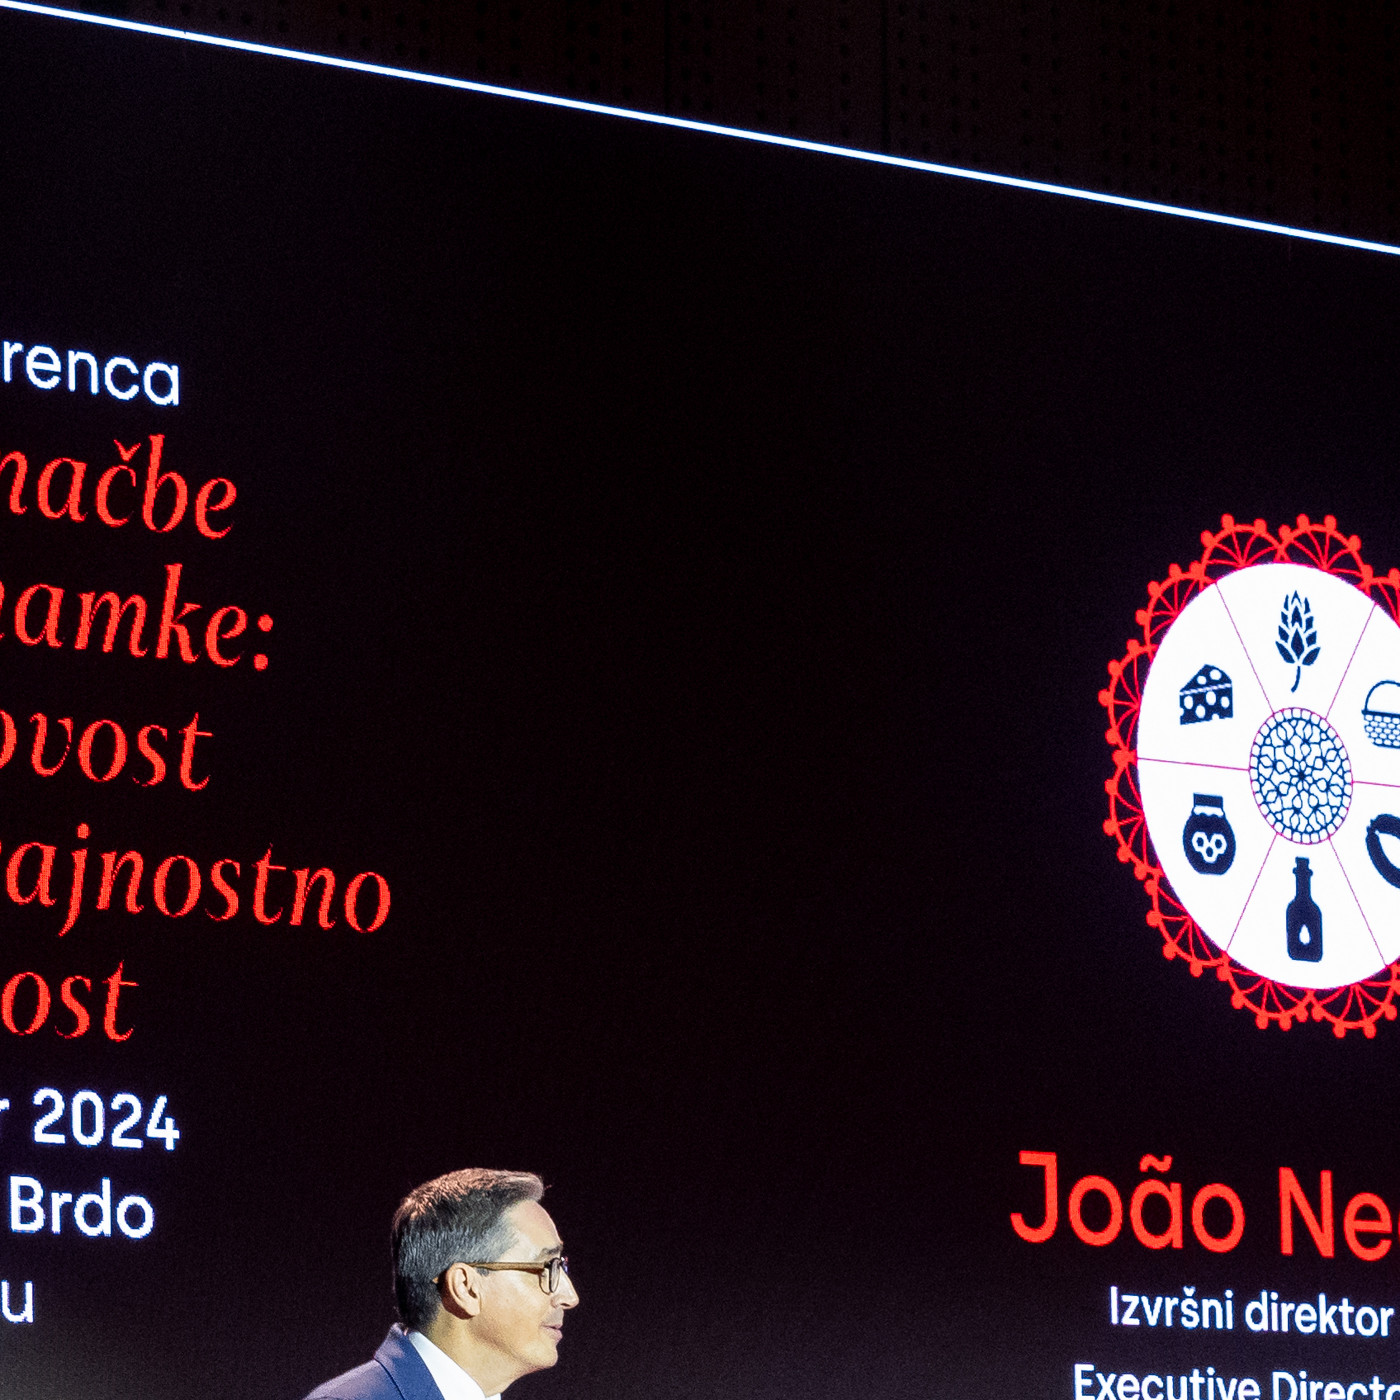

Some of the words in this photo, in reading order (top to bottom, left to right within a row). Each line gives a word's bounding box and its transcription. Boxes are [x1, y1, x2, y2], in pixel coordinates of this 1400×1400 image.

[30, 1085, 181, 1152] 2024
[8, 1174, 156, 1241] Brdo
[1008, 1149, 1247, 1255] João
[1108, 1284, 1235, 1331] Izvršni
[1243, 1288, 1396, 1339] direktor
